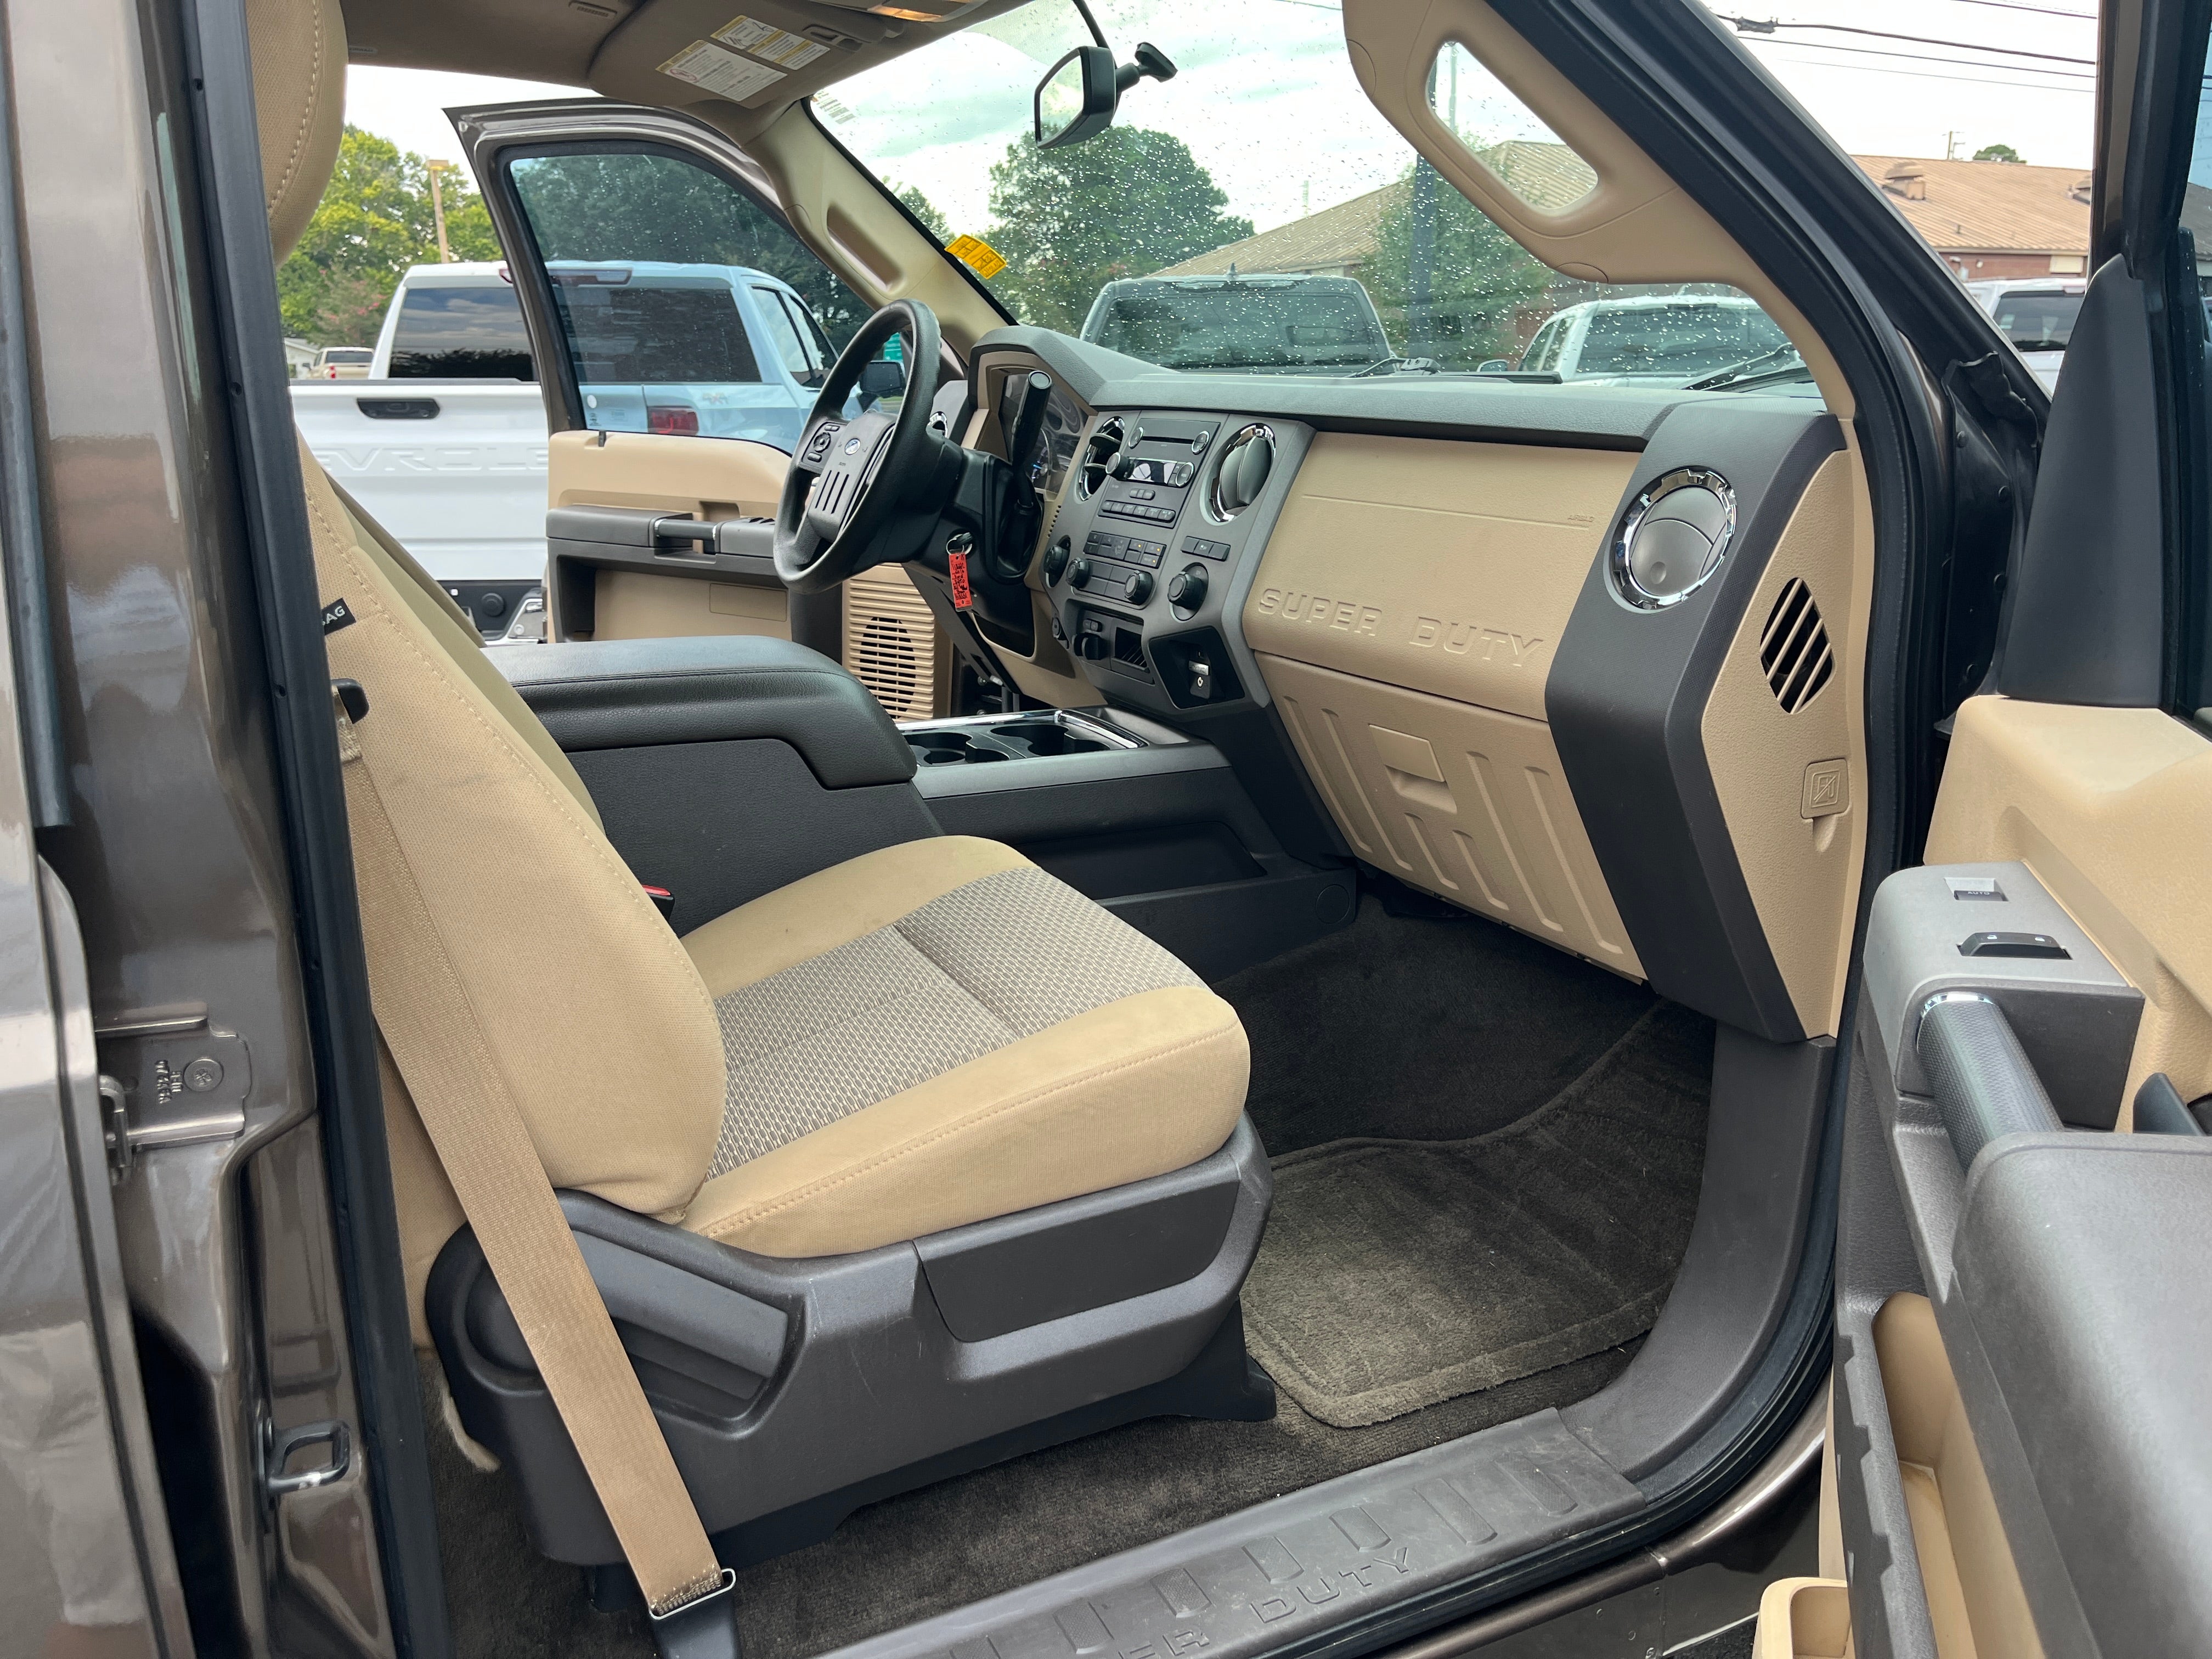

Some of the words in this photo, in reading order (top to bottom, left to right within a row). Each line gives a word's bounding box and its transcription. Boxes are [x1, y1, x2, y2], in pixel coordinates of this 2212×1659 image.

[323, 606, 345, 625] AG
[1258, 588, 1382, 636] SUPER
[1409, 616, 1544, 667] DUTY
[1250, 1547, 1409, 1623] DUTY
